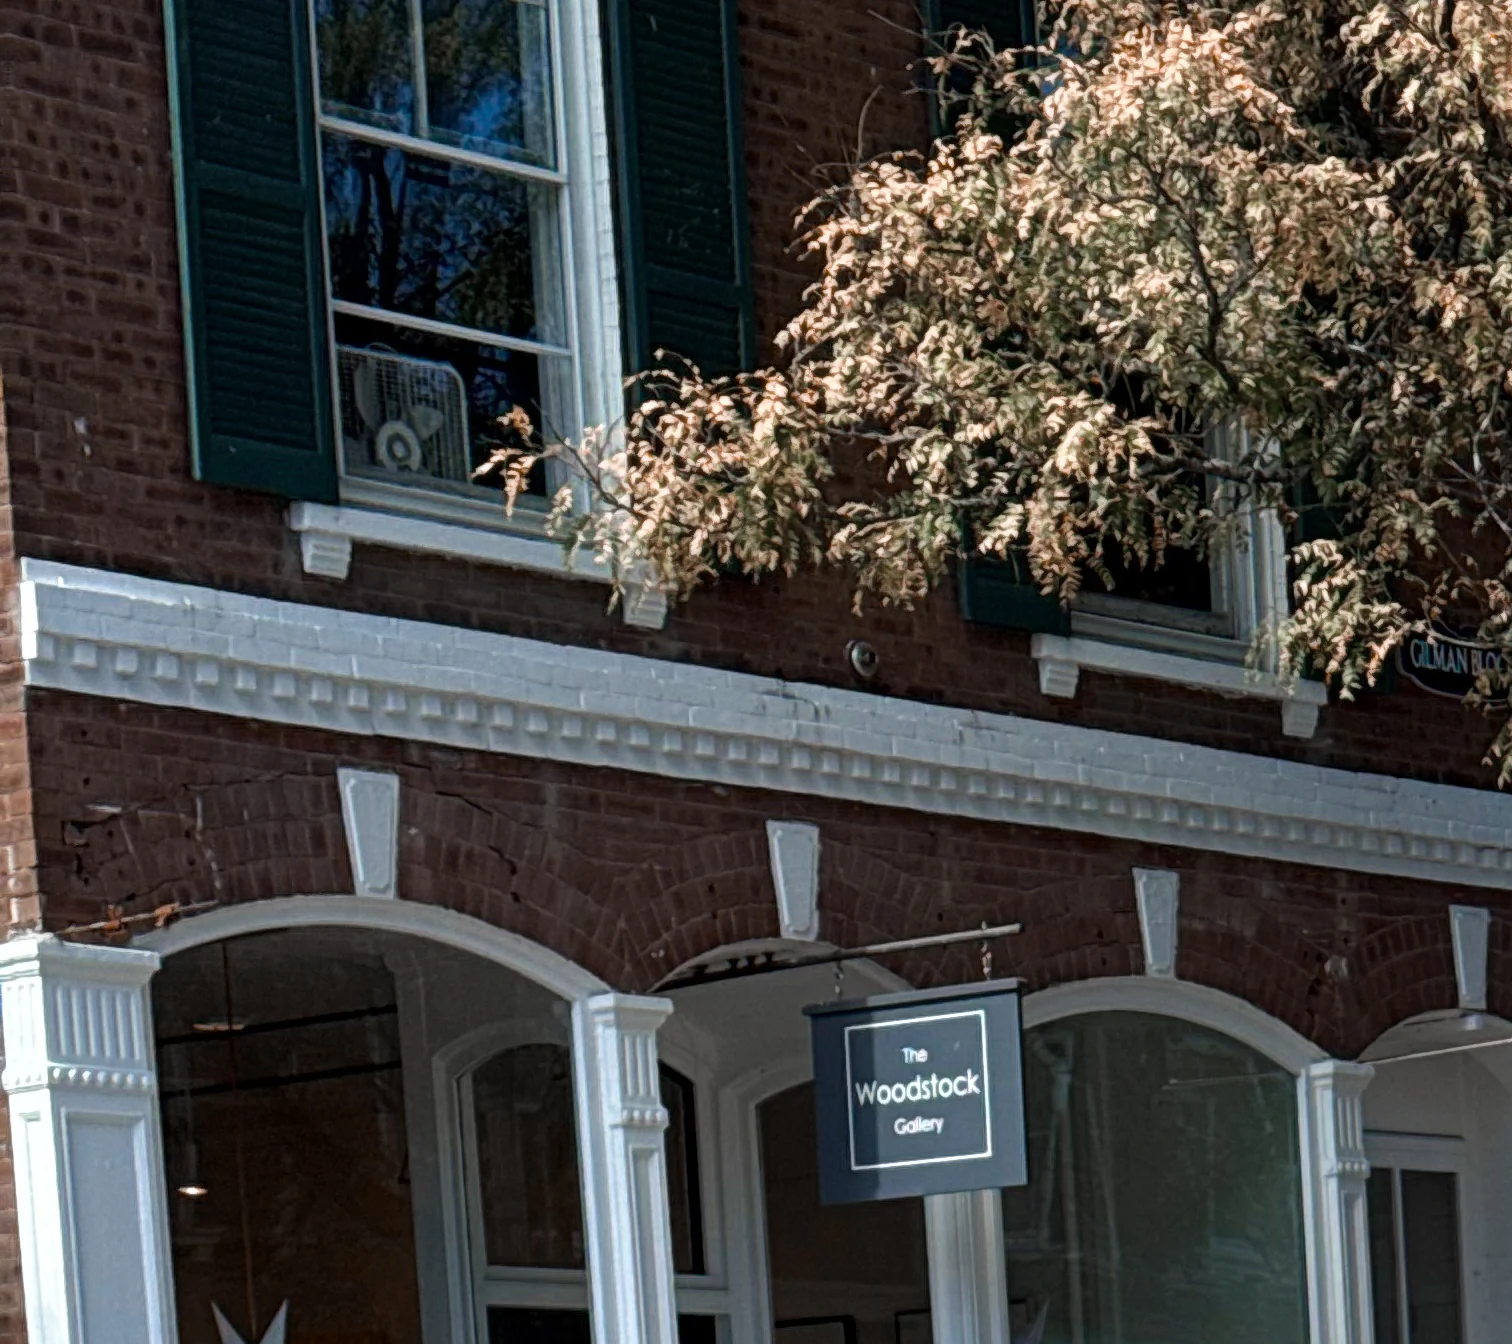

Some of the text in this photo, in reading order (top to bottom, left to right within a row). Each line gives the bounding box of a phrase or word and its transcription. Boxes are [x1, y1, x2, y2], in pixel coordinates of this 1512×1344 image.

[1410, 638, 1468, 675] GILMAN
[900, 1046, 928, 1064] The
[856, 1068, 981, 1106] Woodstock
[893, 1115, 944, 1136] Gallery
